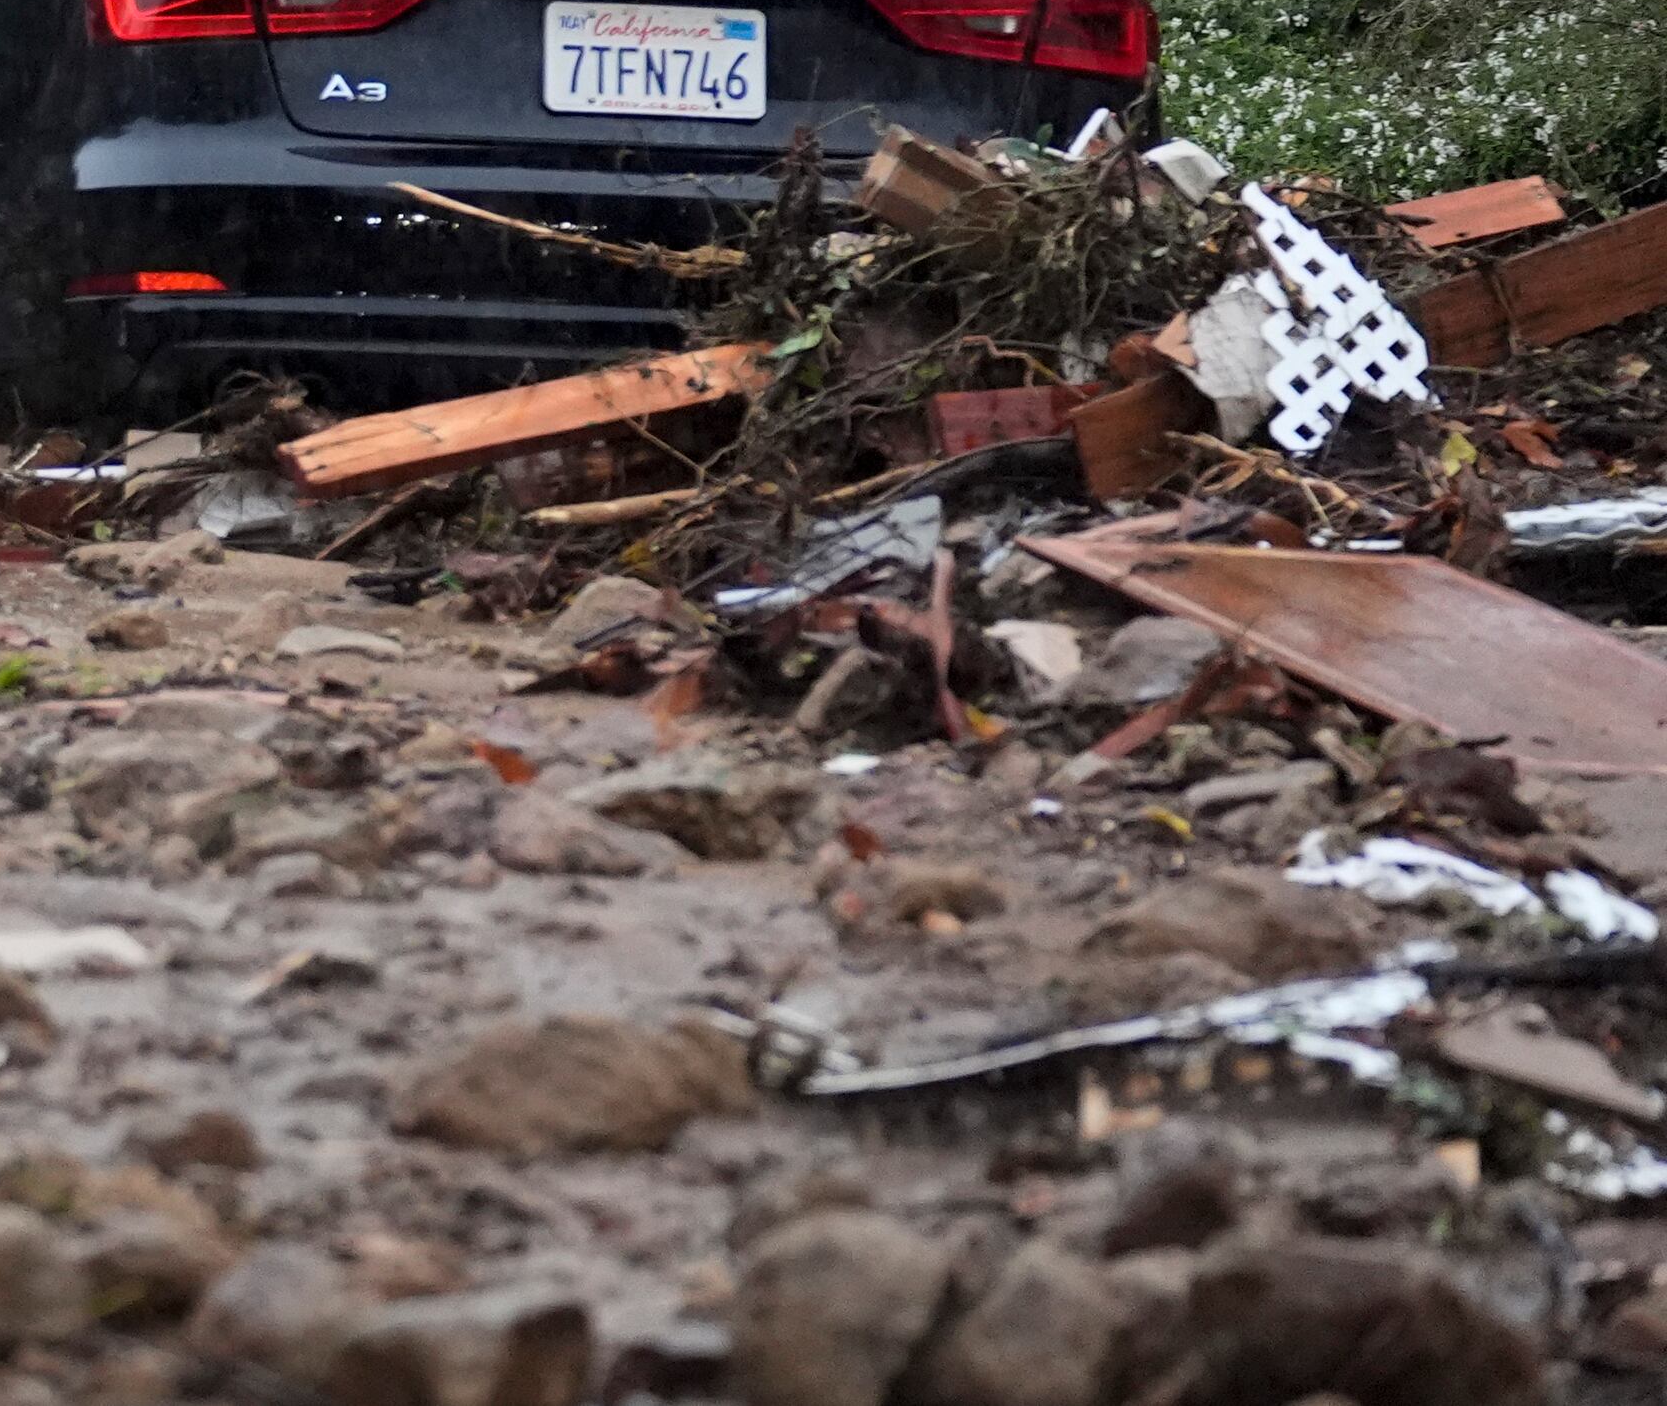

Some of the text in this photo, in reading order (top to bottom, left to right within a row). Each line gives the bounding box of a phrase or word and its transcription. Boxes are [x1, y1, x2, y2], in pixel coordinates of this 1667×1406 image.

[593, 12, 711, 44] California
[319, 73, 387, 102] A3
[562, 44, 749, 100] 7TFN746
